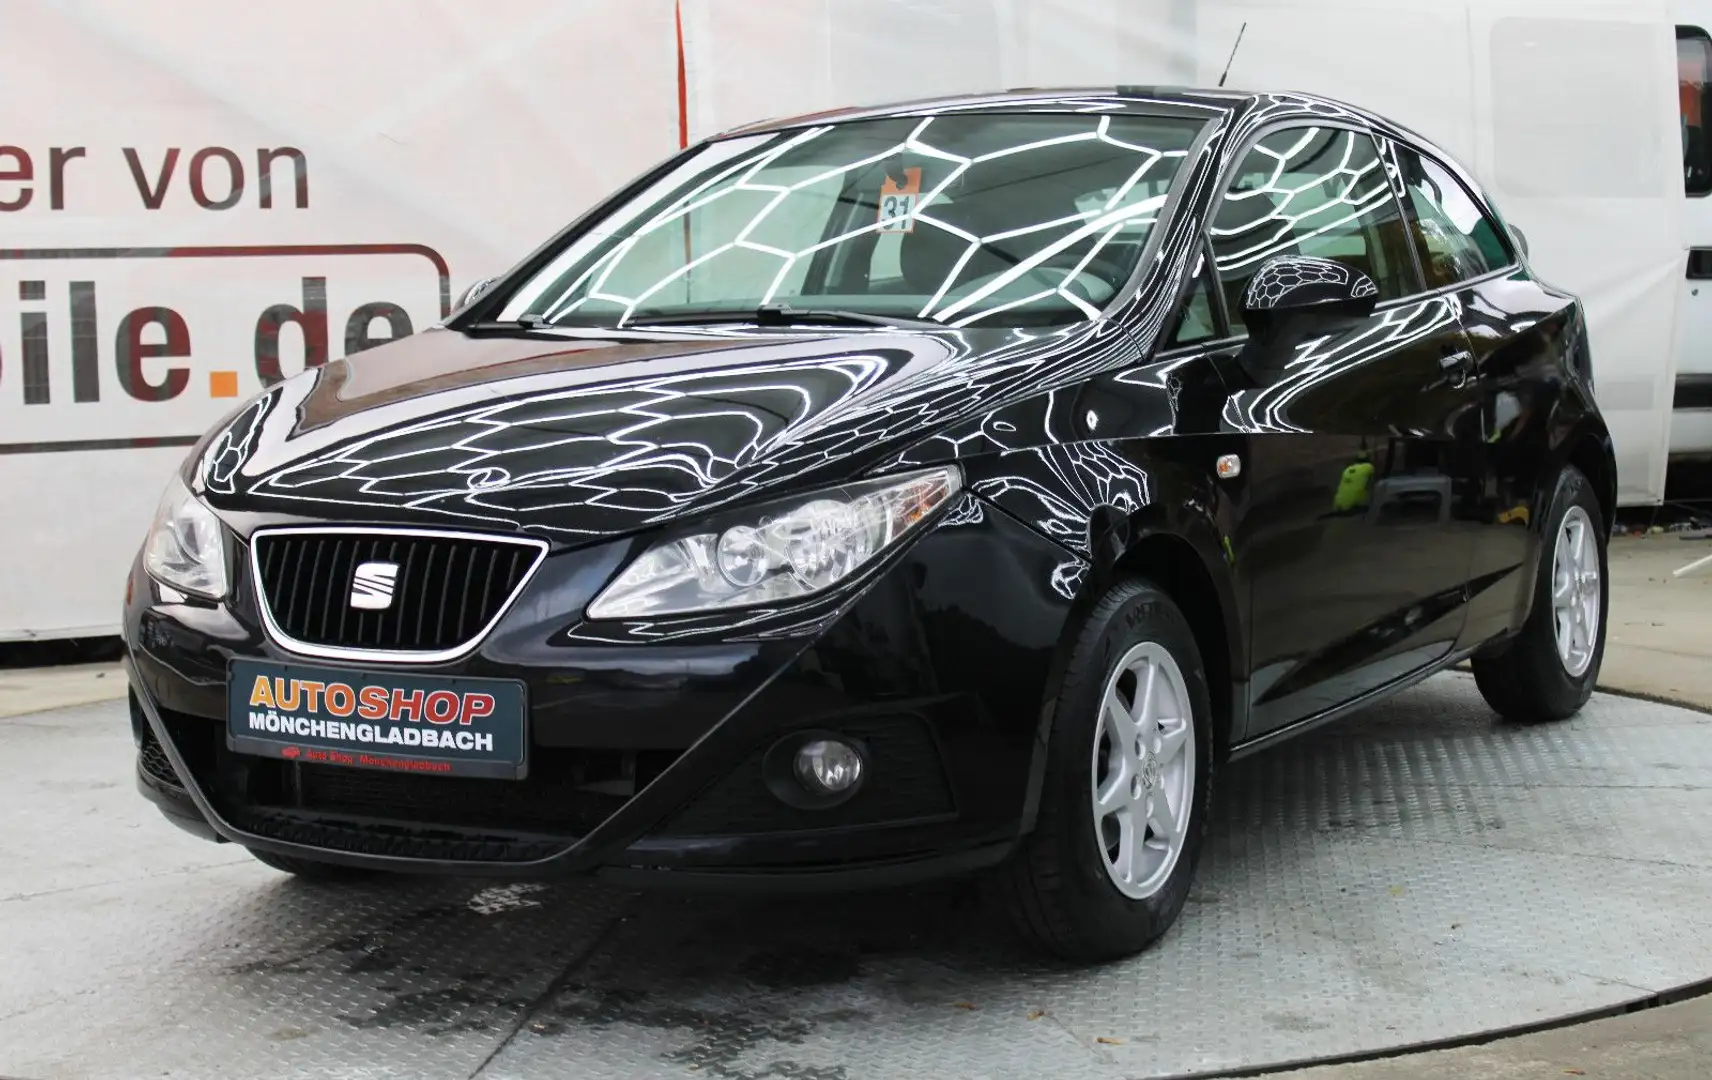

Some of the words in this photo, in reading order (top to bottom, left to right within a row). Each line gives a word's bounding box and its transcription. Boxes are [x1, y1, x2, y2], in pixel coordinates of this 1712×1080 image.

[122, 146, 309, 211] von
[883, 195, 910, 230] 31
[0, 276, 414, 405] ile.de
[249, 675, 496, 726] AUTOSHOP
[249, 711, 493, 751] MÖNCHENGLADBACH
